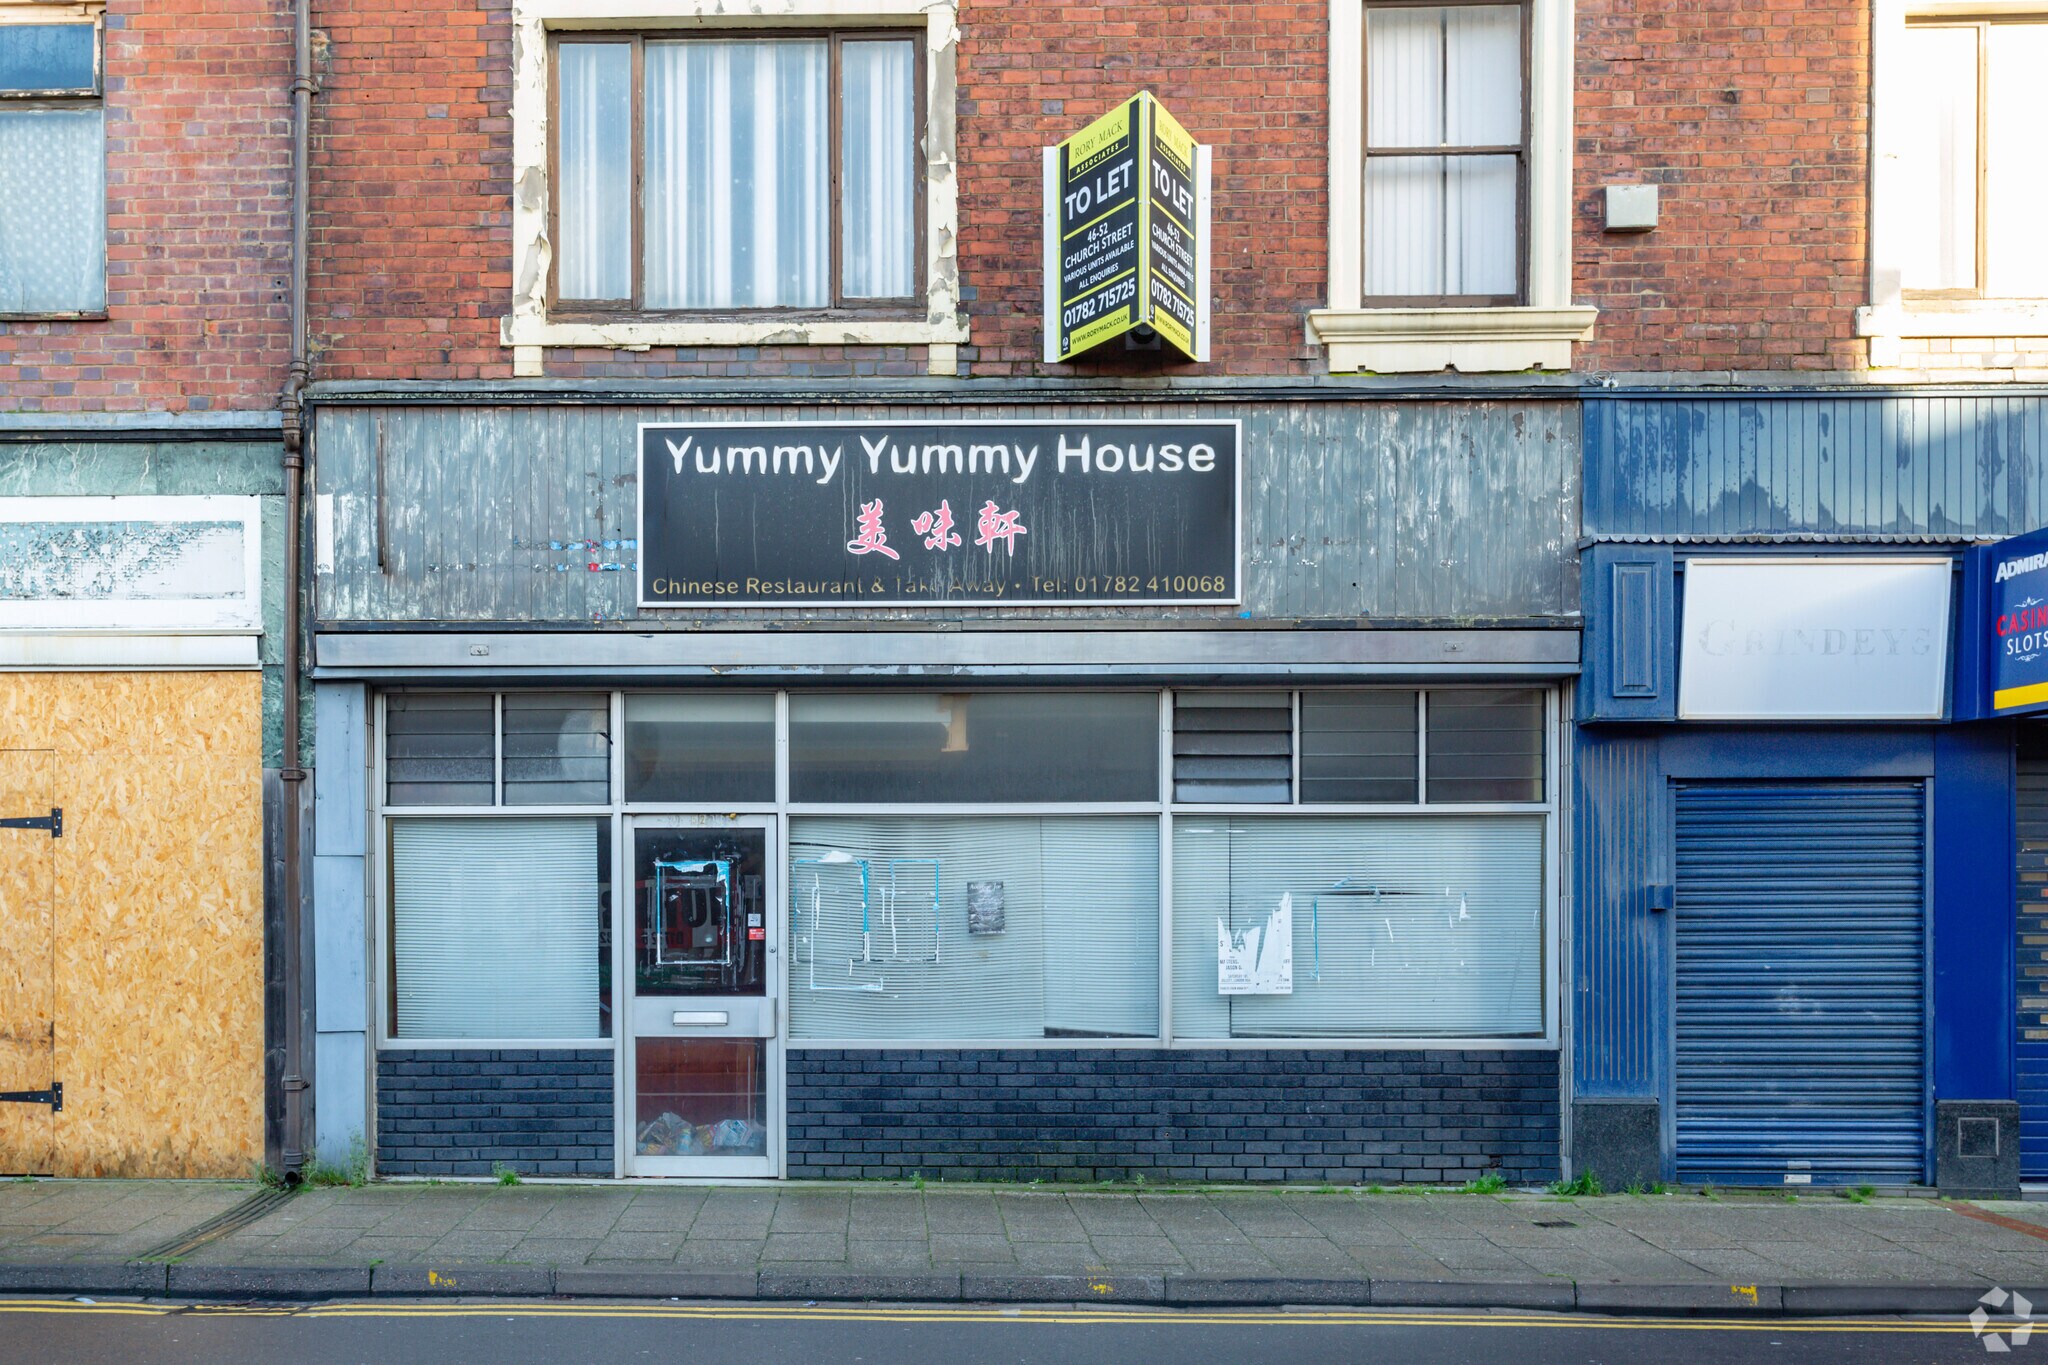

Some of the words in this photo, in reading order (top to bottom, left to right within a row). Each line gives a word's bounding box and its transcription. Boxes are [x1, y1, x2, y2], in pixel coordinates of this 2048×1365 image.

[1075, 136, 1096, 159] RORY
[1099, 120, 1122, 144] MACK
[1076, 142, 1119, 174] ASSOCIATES
[1160, 142, 1186, 173] ASSOCIATES
[1064, 186, 1091, 221] TO
[1096, 158, 1133, 206] LET
[1152, 159, 1170, 197] TO
[1172, 178, 1194, 220] LET
[1065, 240, 1100, 269] CHURCH
[1101, 222, 1133, 250] STREET
[1087, 222, 1108, 242] 46-52
[1152, 223, 1175, 252] CHURCH
[1175, 243, 1193, 268] STREET
[1064, 265, 1087, 283] VARIOUS
[1088, 256, 1104, 271] UNITS
[1105, 240, 1135, 262] AVAILABLE
[1079, 278, 1089, 290] ALL
[1090, 262, 1119, 284] ENQUIRIES
[1064, 298, 1096, 328] 01782
[1098, 277, 1136, 312] 715725
[1151, 278, 1171, 310] 01782
[1172, 295, 1195, 328] 715725
[1071, 313, 1128, 345] WWW.RORYMACK.CO.UK
[664, 434, 842, 485] Yummy
[859, 433, 1039, 484] Yummy
[1057, 433, 1216, 474] House
[652, 577, 739, 595] Chinese
[871, 577, 885, 594] &
[1031, 575, 1067, 593] Tel:
[1074, 575, 1140, 593] 01782
[1146, 575, 1226, 593] 410068
